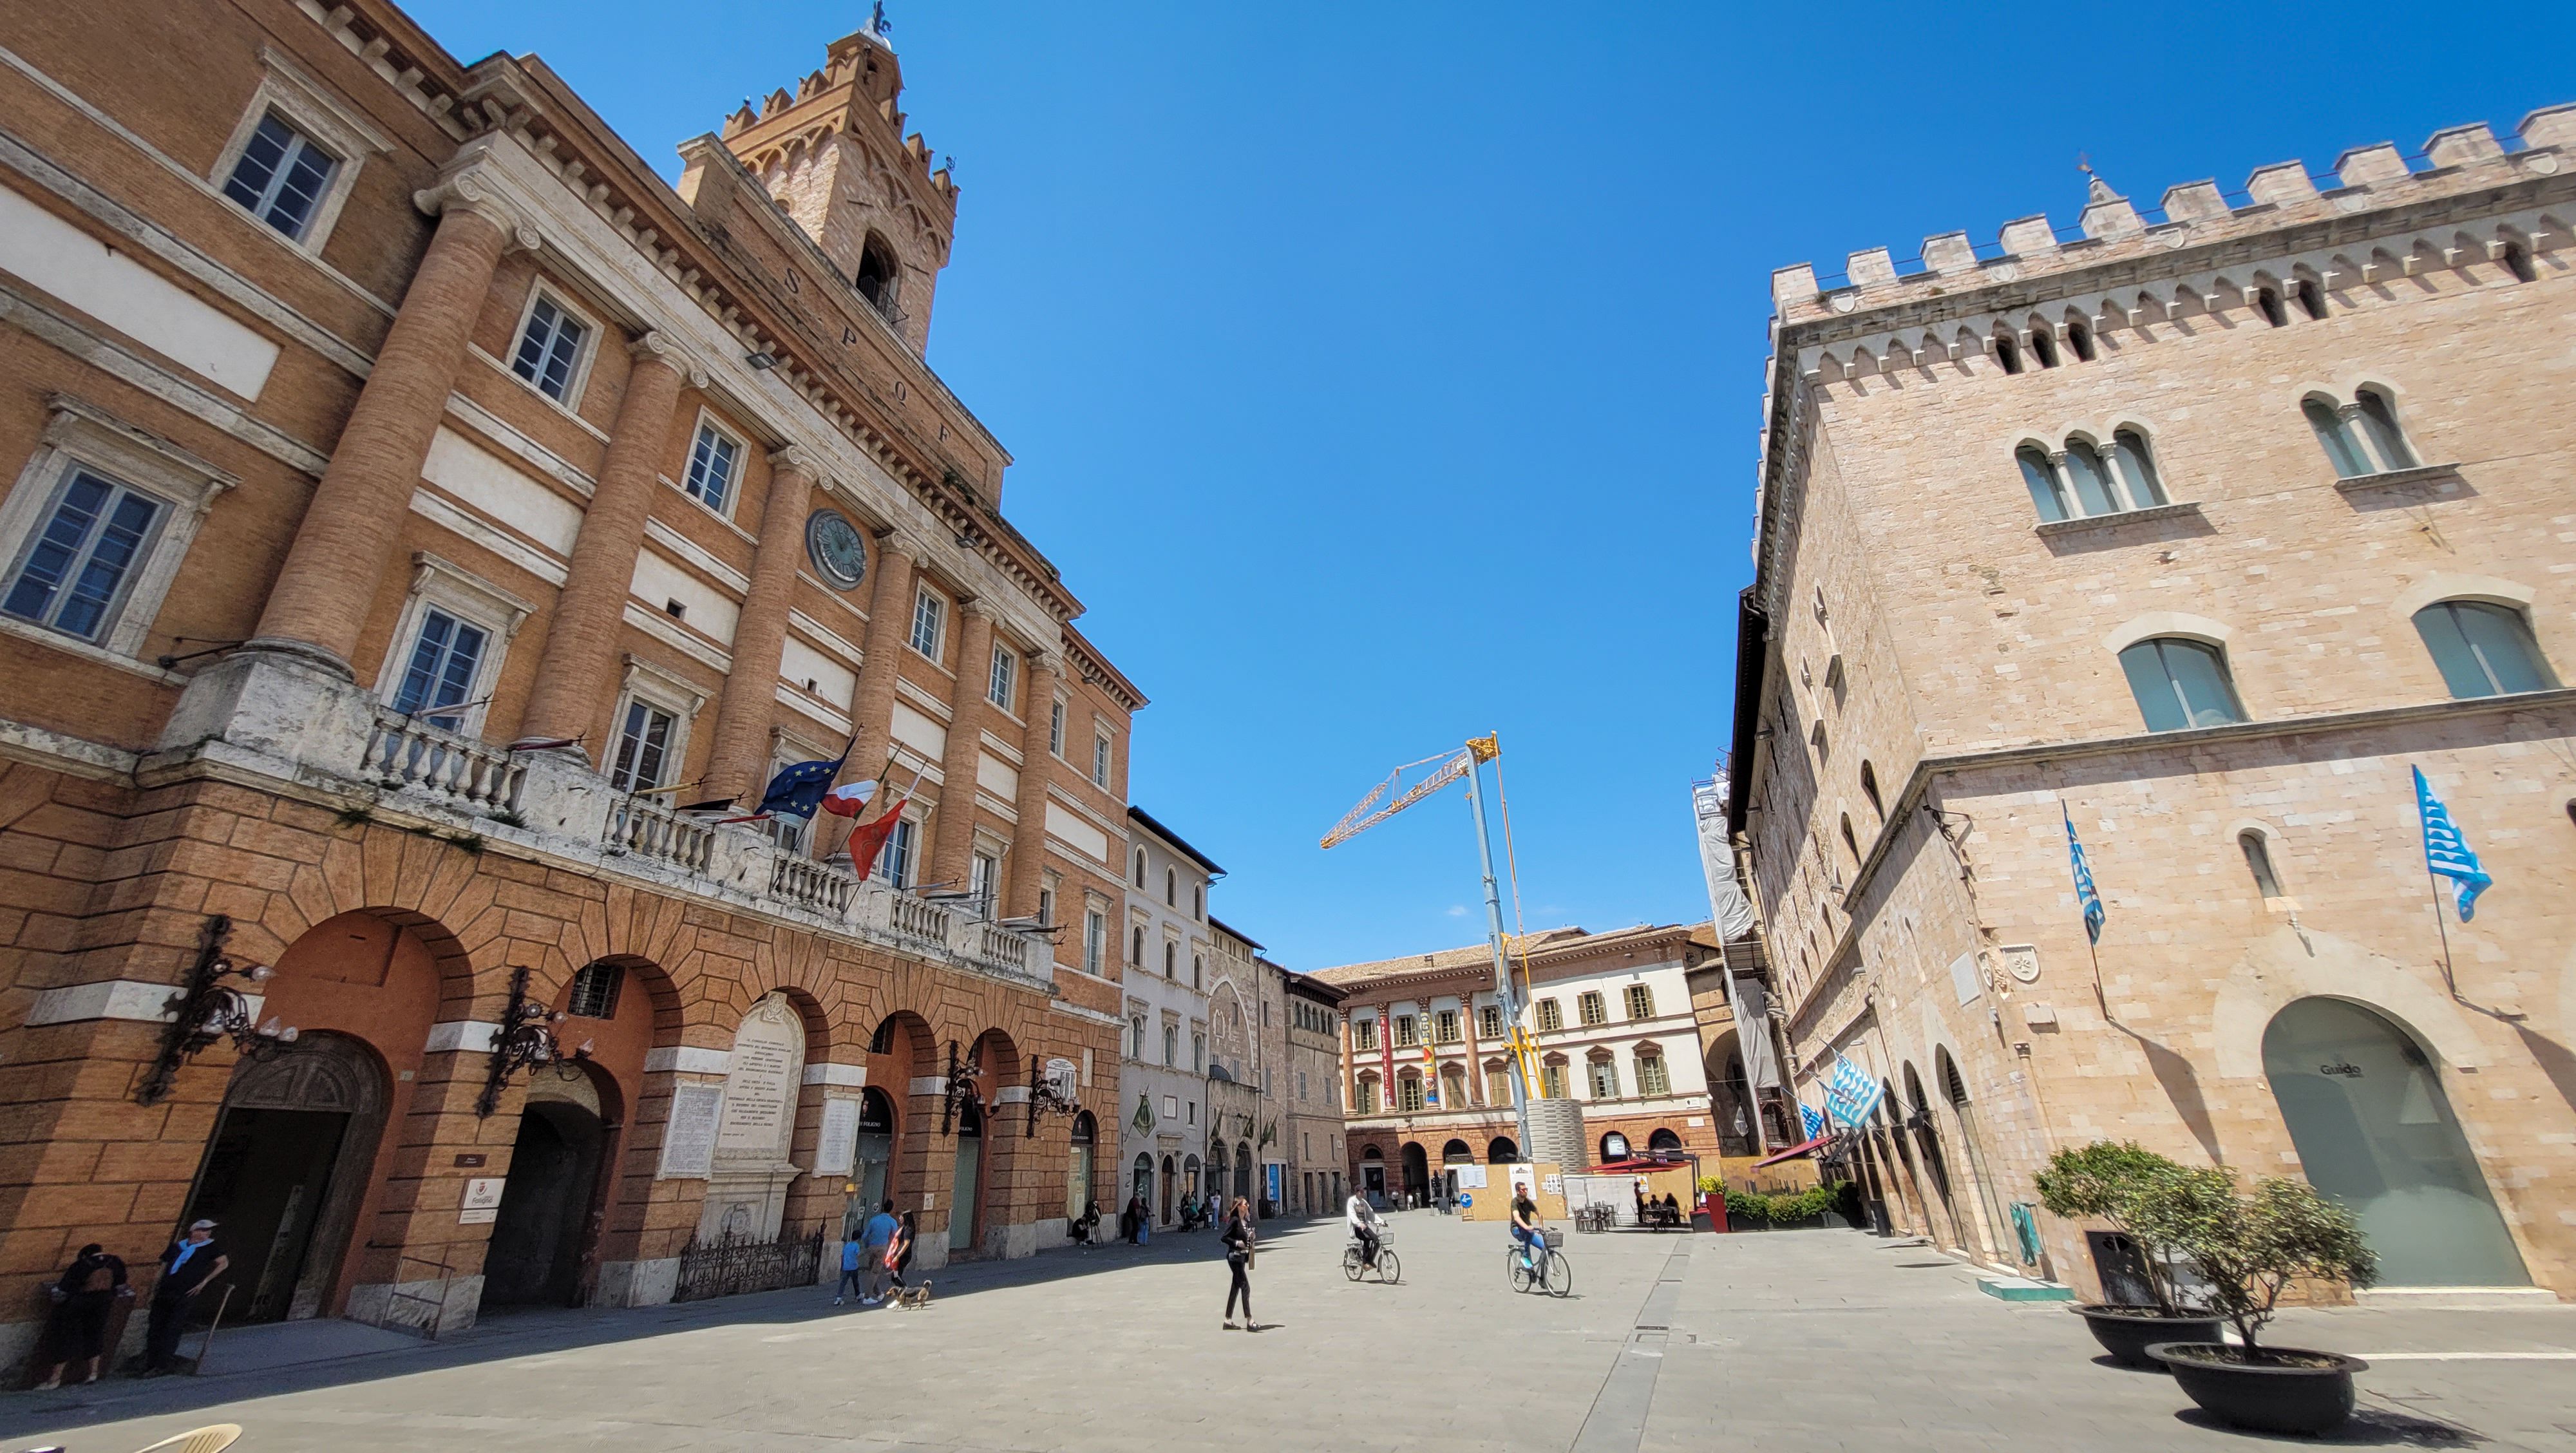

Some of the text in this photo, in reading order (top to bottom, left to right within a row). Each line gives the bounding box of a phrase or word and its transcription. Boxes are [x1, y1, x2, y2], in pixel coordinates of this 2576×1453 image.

[784, 267, 951, 443] S P Q F
[2320, 1063, 2362, 1075] Guido
